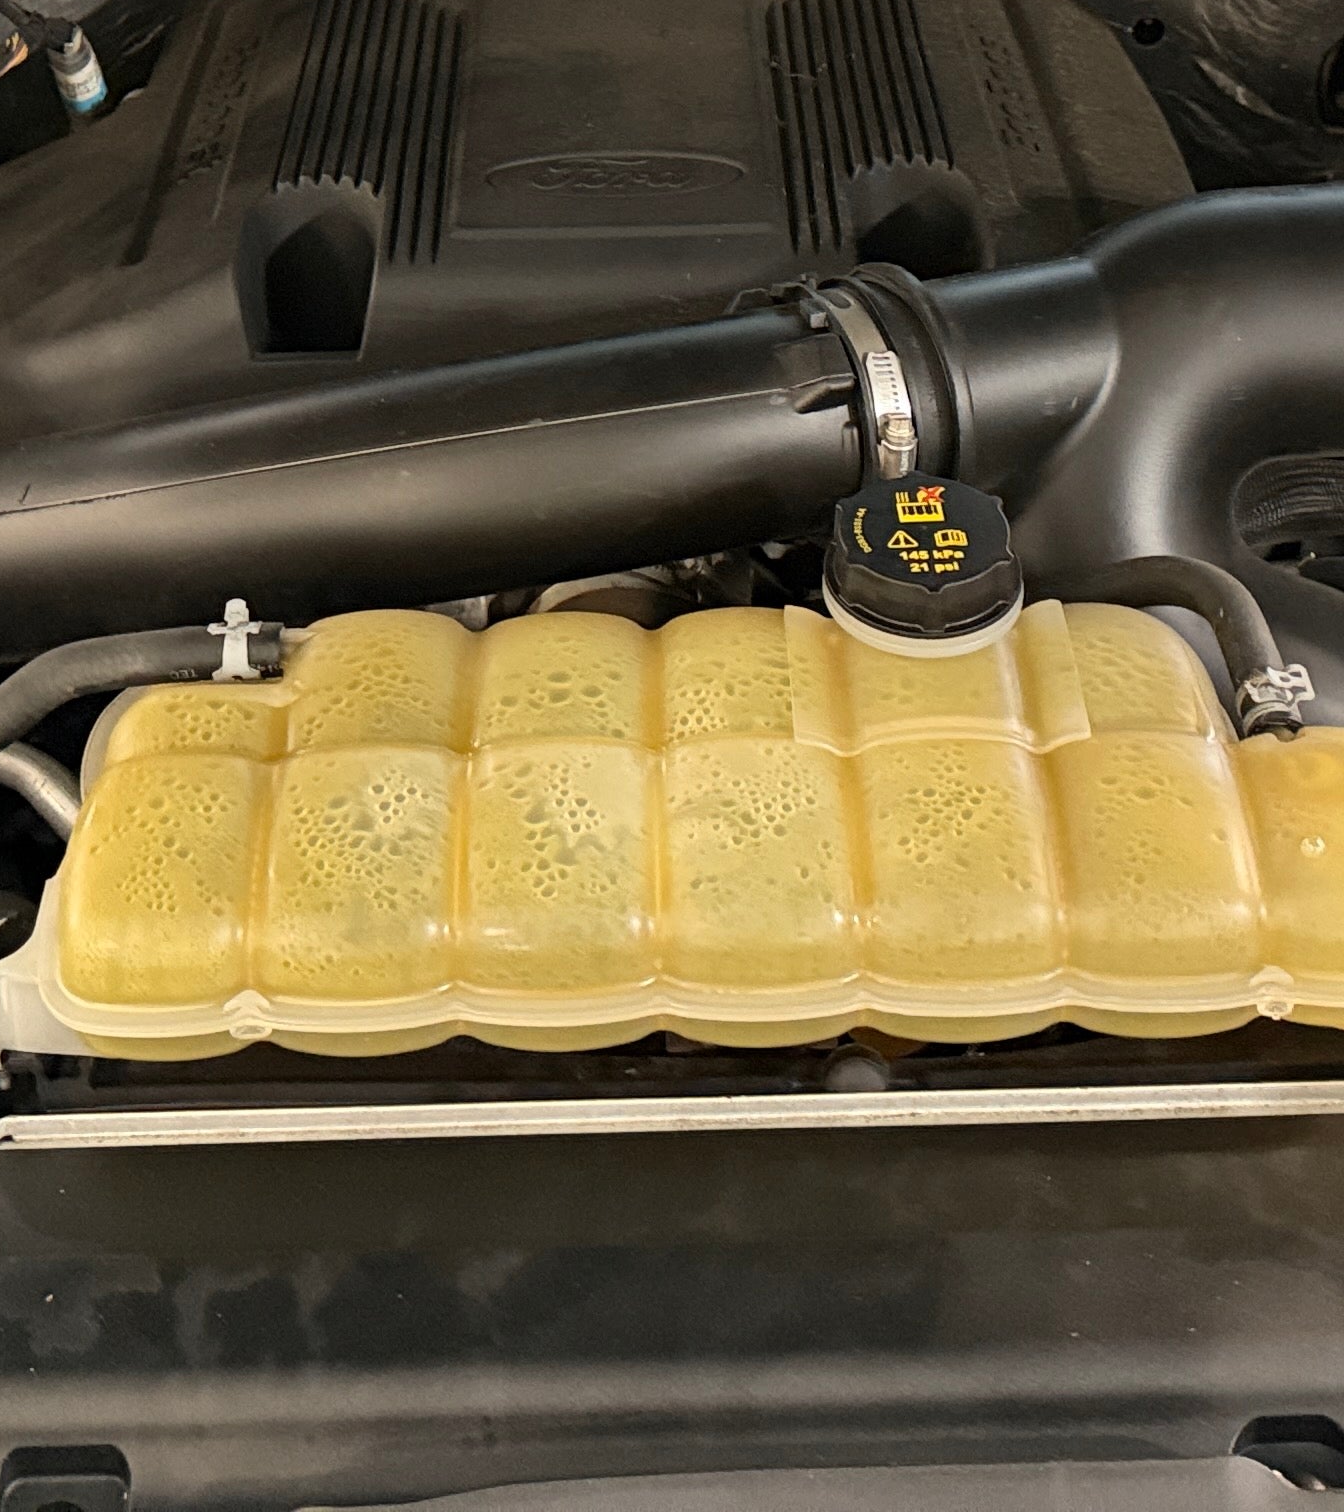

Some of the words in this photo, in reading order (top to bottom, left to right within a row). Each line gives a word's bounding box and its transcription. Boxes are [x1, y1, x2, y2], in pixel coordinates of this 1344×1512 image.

[899, 550, 930, 561] 145
[932, 549, 965, 560] kPa
[909, 562, 930, 573] 21
[933, 561, 960, 573] psi
